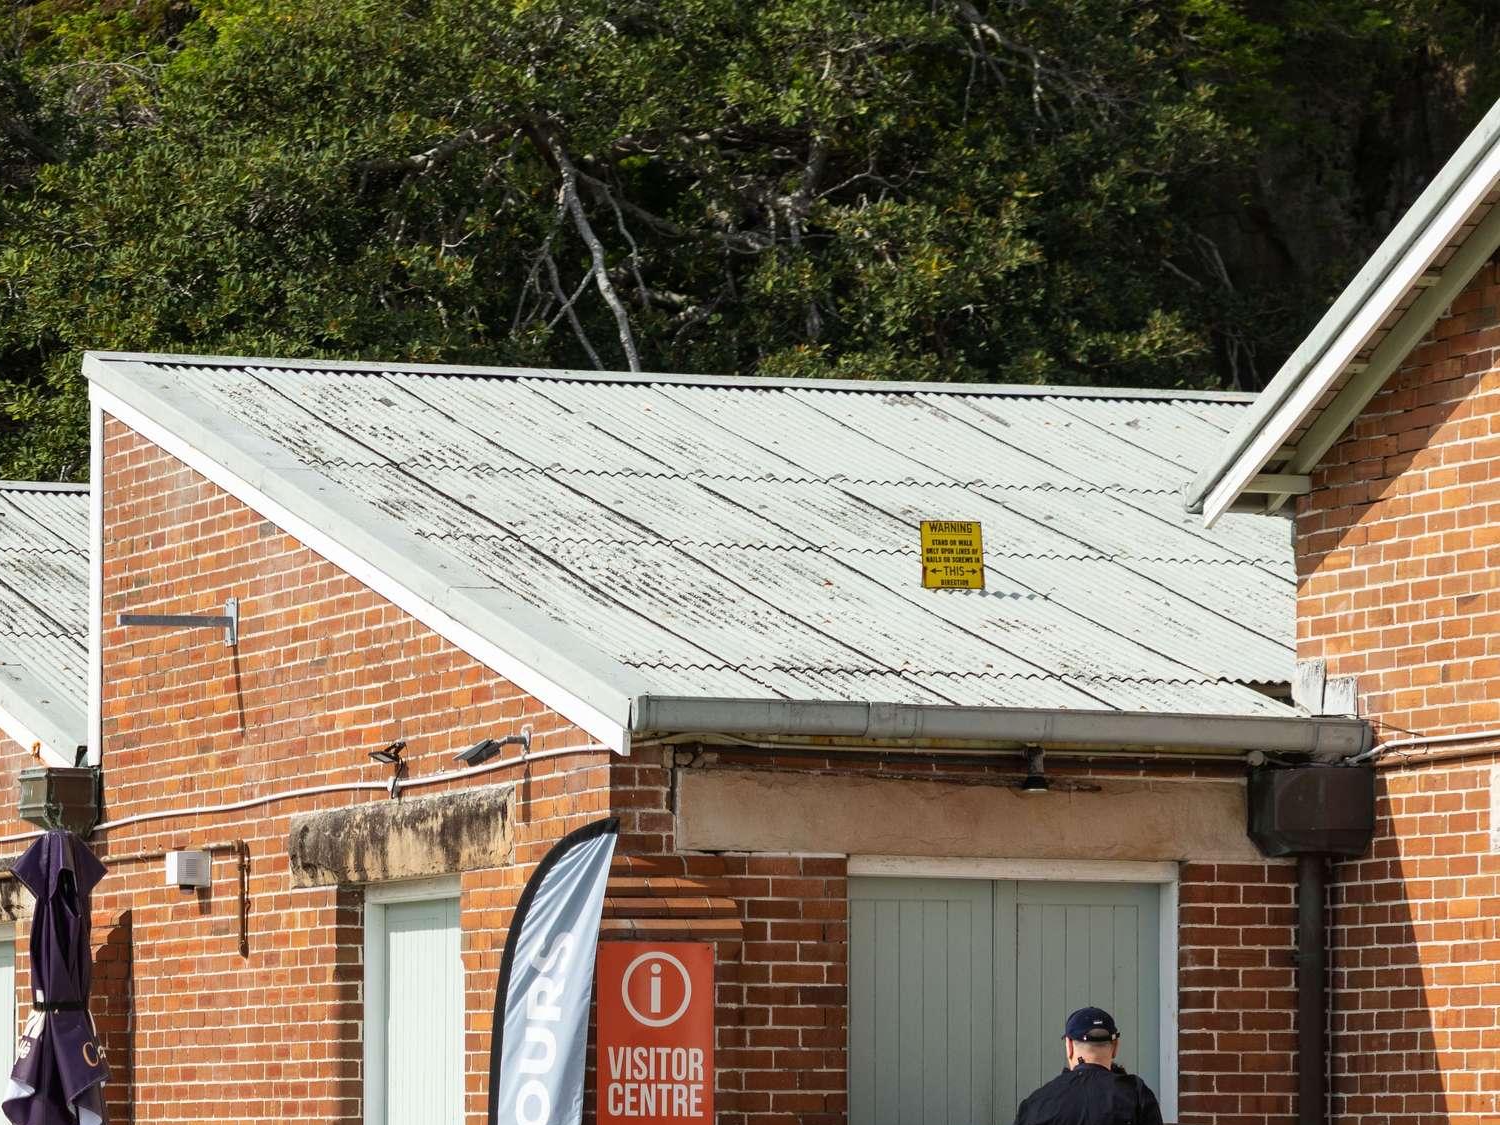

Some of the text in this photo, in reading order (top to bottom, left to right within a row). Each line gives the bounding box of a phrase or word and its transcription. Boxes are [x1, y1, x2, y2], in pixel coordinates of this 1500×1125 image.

[929, 522, 973, 534] WARNING
[943, 566, 965, 576] THIS
[607, 1046, 704, 1082] VISITOR
[607, 1083, 704, 1118] CENTRE
